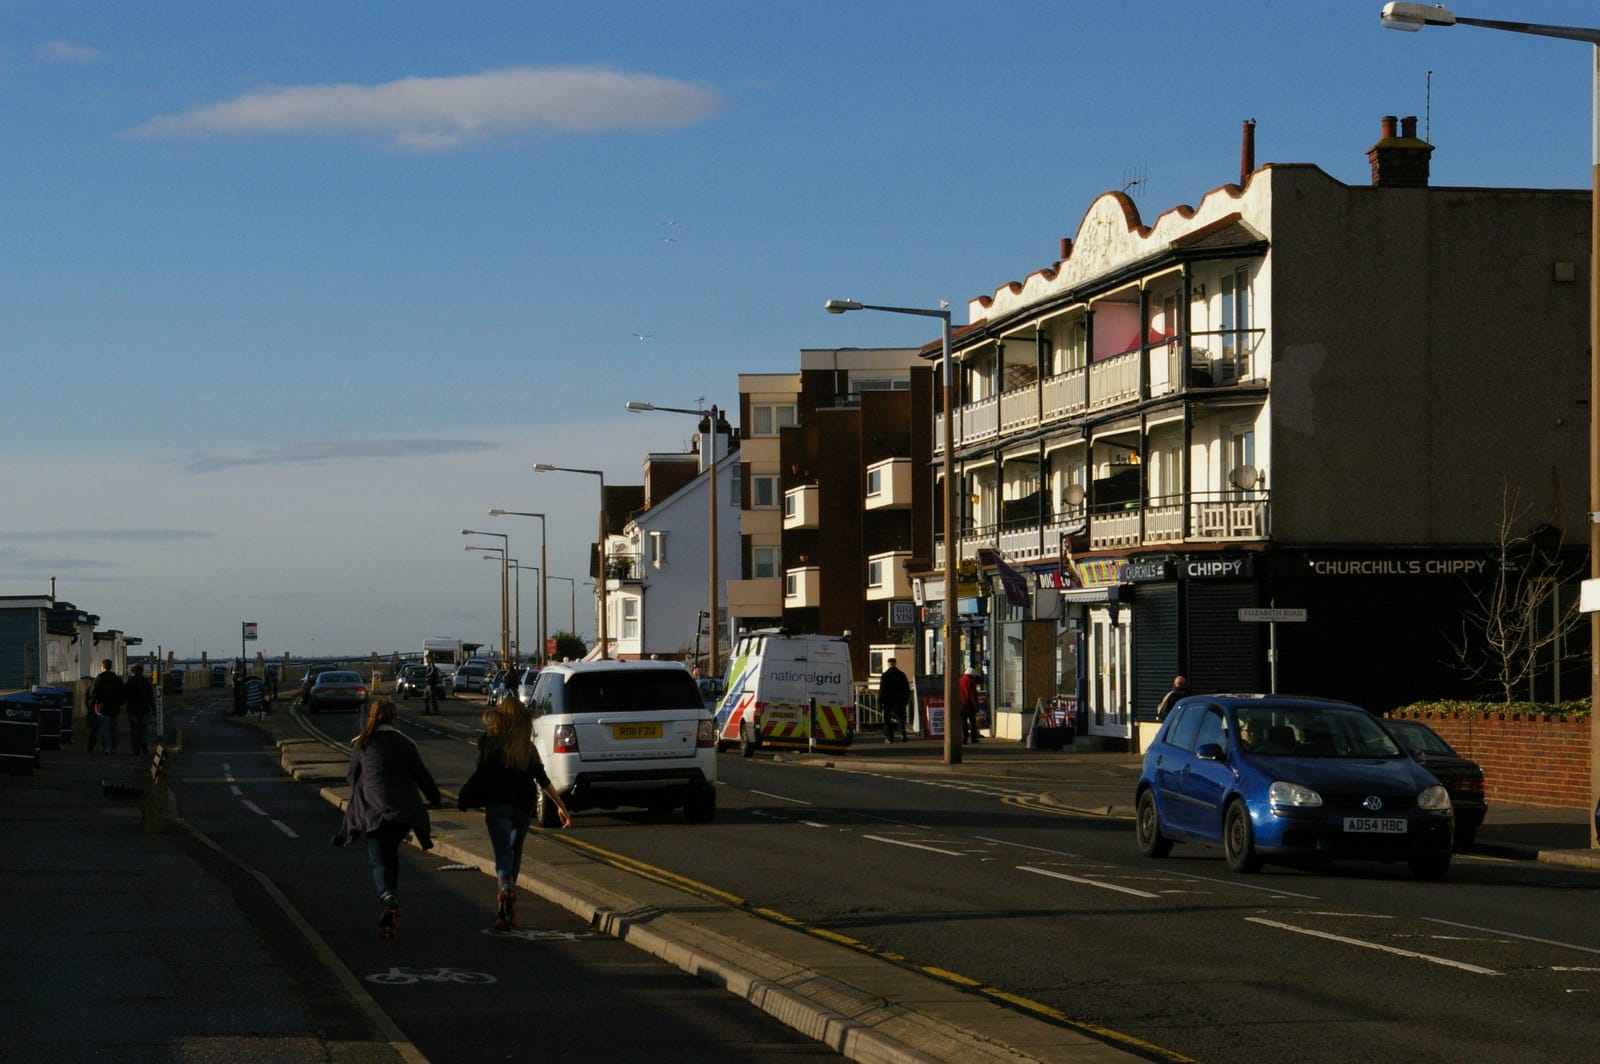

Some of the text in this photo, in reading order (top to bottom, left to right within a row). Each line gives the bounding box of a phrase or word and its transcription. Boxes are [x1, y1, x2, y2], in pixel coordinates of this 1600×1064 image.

[1187, 560, 1242, 577] CHIPPY
[1314, 559, 1421, 575] CHURCHILL'S
[1425, 559, 1488, 574] CHIPPY
[896, 604, 912, 613] BIG
[1244, 609, 1303, 617] ELIZABETH ROAD
[896, 613, 912, 621] YIN
[770, 671, 841, 685] nationalgrid
[1348, 821, 1404, 832] AD54 HBC
